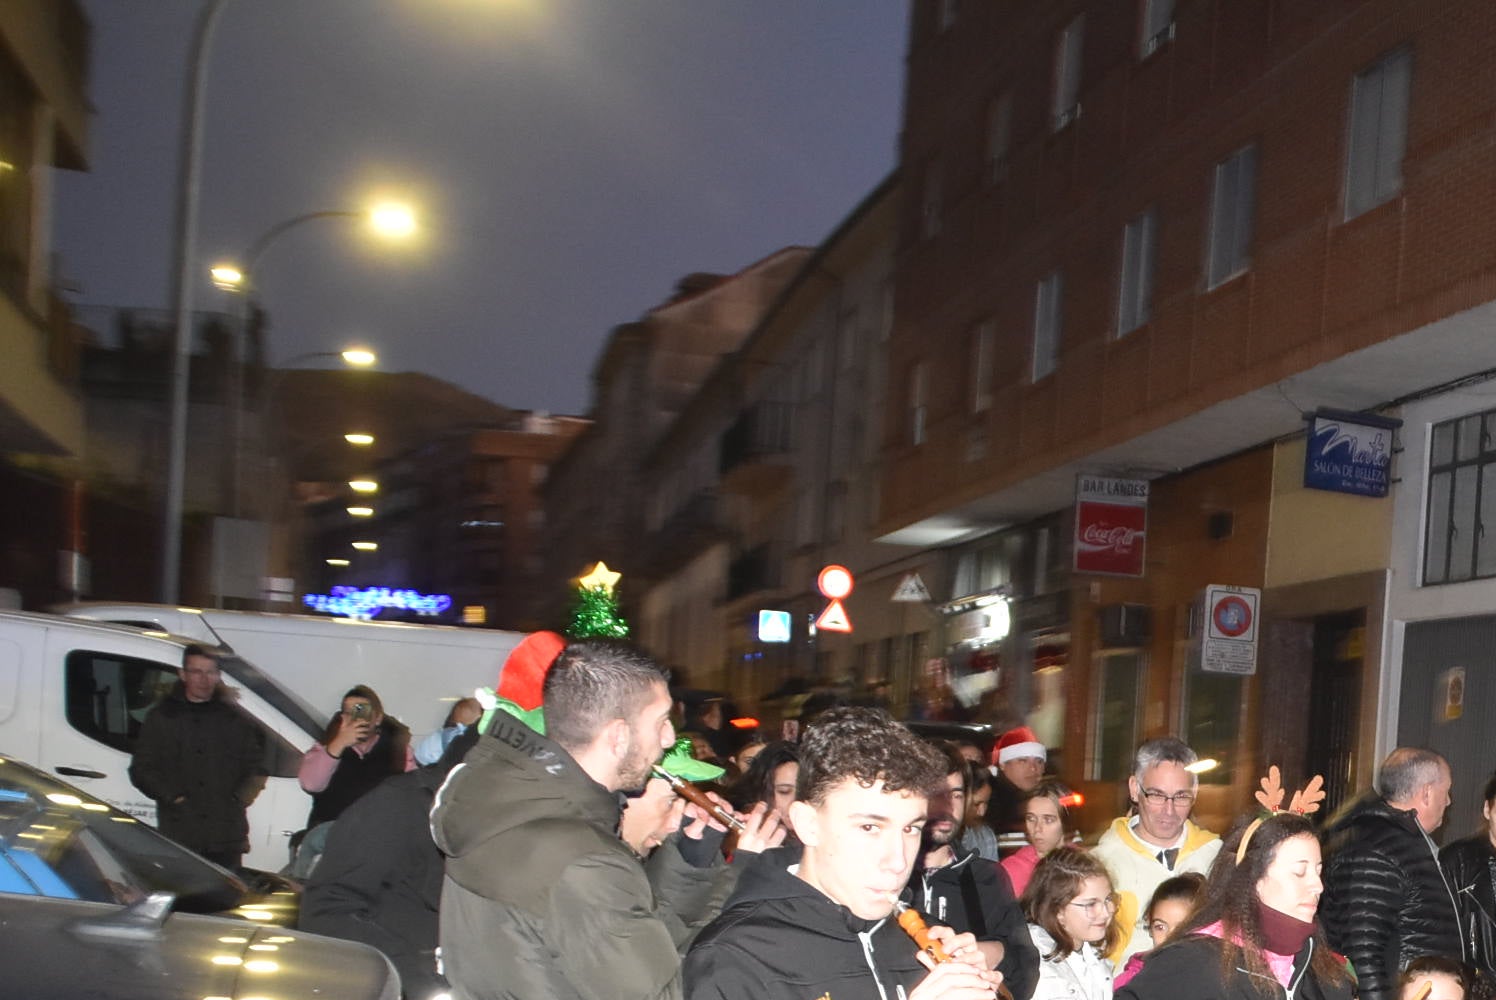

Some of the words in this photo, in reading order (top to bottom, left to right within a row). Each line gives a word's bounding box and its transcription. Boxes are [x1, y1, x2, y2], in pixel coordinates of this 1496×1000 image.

[1342, 465, 1353, 478] DE
[1355, 466, 1386, 482] BELLEZA
[1083, 480, 1104, 493] BAR
[1107, 482, 1147, 497] LANDES
